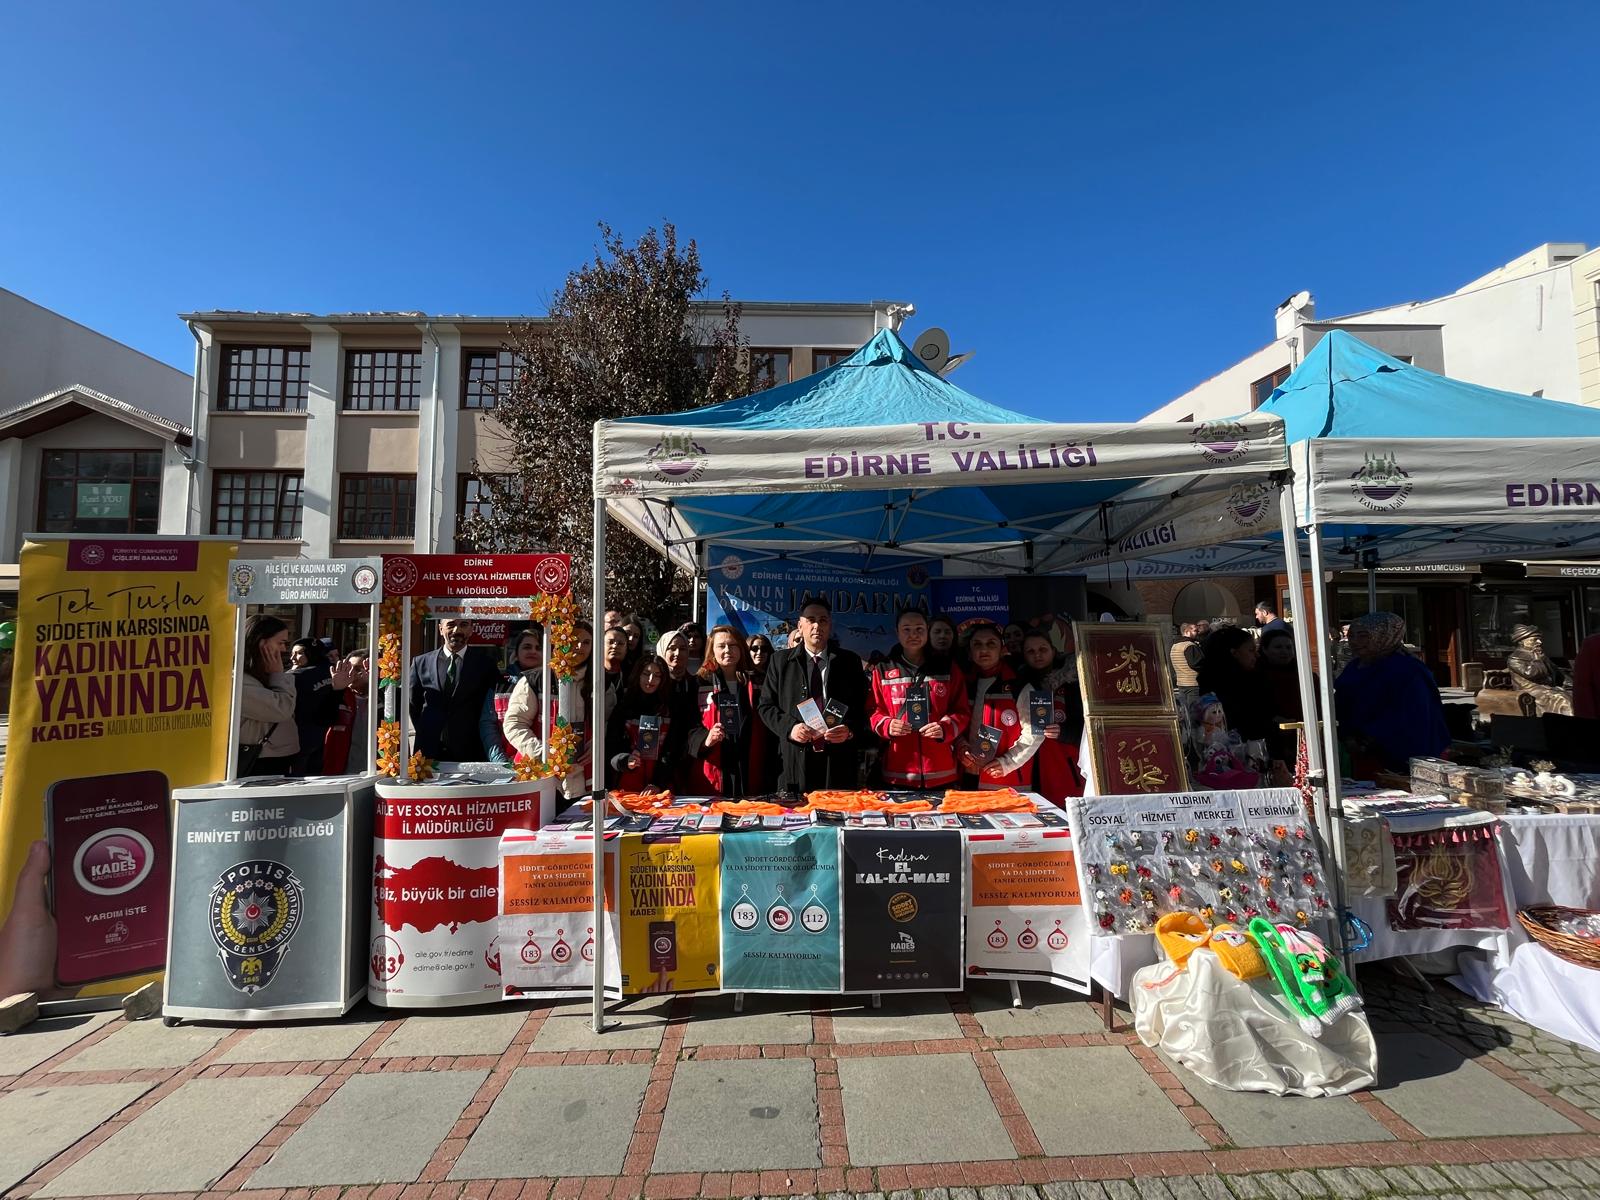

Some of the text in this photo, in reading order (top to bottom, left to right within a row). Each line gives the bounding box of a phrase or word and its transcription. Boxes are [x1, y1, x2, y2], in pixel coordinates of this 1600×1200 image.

[918, 422, 980, 441] T.C.
[804, 441, 1097, 479] EDİRNE VALİLİĞİ
[265, 563, 347, 575] AİLE İÇİ VE KADINA KARŞI
[464, 558, 493, 567] EDİRNE
[272, 576, 339, 589] ŞİDDETLE MÜCADELE
[422, 572, 532, 581] AİLE VE SOSYAL HİZMETLER
[752, 571, 783, 581] EDİRNE
[795, 574, 840, 583] JANDARMA
[280, 588, 329, 600] BÜRO AMİRLİĞİ
[447, 585, 508, 595] İL MÜDÜRLÜĞÜ
[719, 584, 785, 600] KANUN
[36, 581, 205, 623] Tek Tuşla
[719, 598, 785, 613] ORDUSU
[35, 634, 210, 676] KADINLARIN
[36, 668, 210, 722] YANINDA
[32, 721, 104, 743] KADES
[376, 799, 533, 816] AİLE VE SOSYAL HİZMETLER
[1168, 796, 1212, 805] YILDIRIM
[231, 807, 285, 823] EDİRNE
[1089, 804, 1296, 825] SOSYAL HİZMET MERKEZİ EK BİRİMİ
[187, 822, 334, 844] EMNİYET MÜDÜRLÜĞÜ
[402, 818, 494, 834] İL MÜDÜRLÜĞÜ
[91, 860, 137, 877] KADES
[227, 863, 285, 883] POLİS
[895, 862, 911, 873] EL
[630, 873, 696, 888] KADINLARIN
[855, 872, 951, 884] KAL-KA-MAZ!
[401, 887, 444, 904] büyük
[448, 887, 466, 899] bir
[510, 895, 540, 907] SESSİZ
[630, 888, 696, 907] YANINDA
[85, 905, 148, 923] YARDIM İSTE
[630, 908, 657, 916] KADES
[737, 911, 754, 920] 183
[805, 914, 823, 923] 112
[234, 943, 272, 954] GENEL
[890, 942, 916, 950] KADES
[524, 950, 539, 958] 183
[743, 951, 767, 959] SESSİZ
